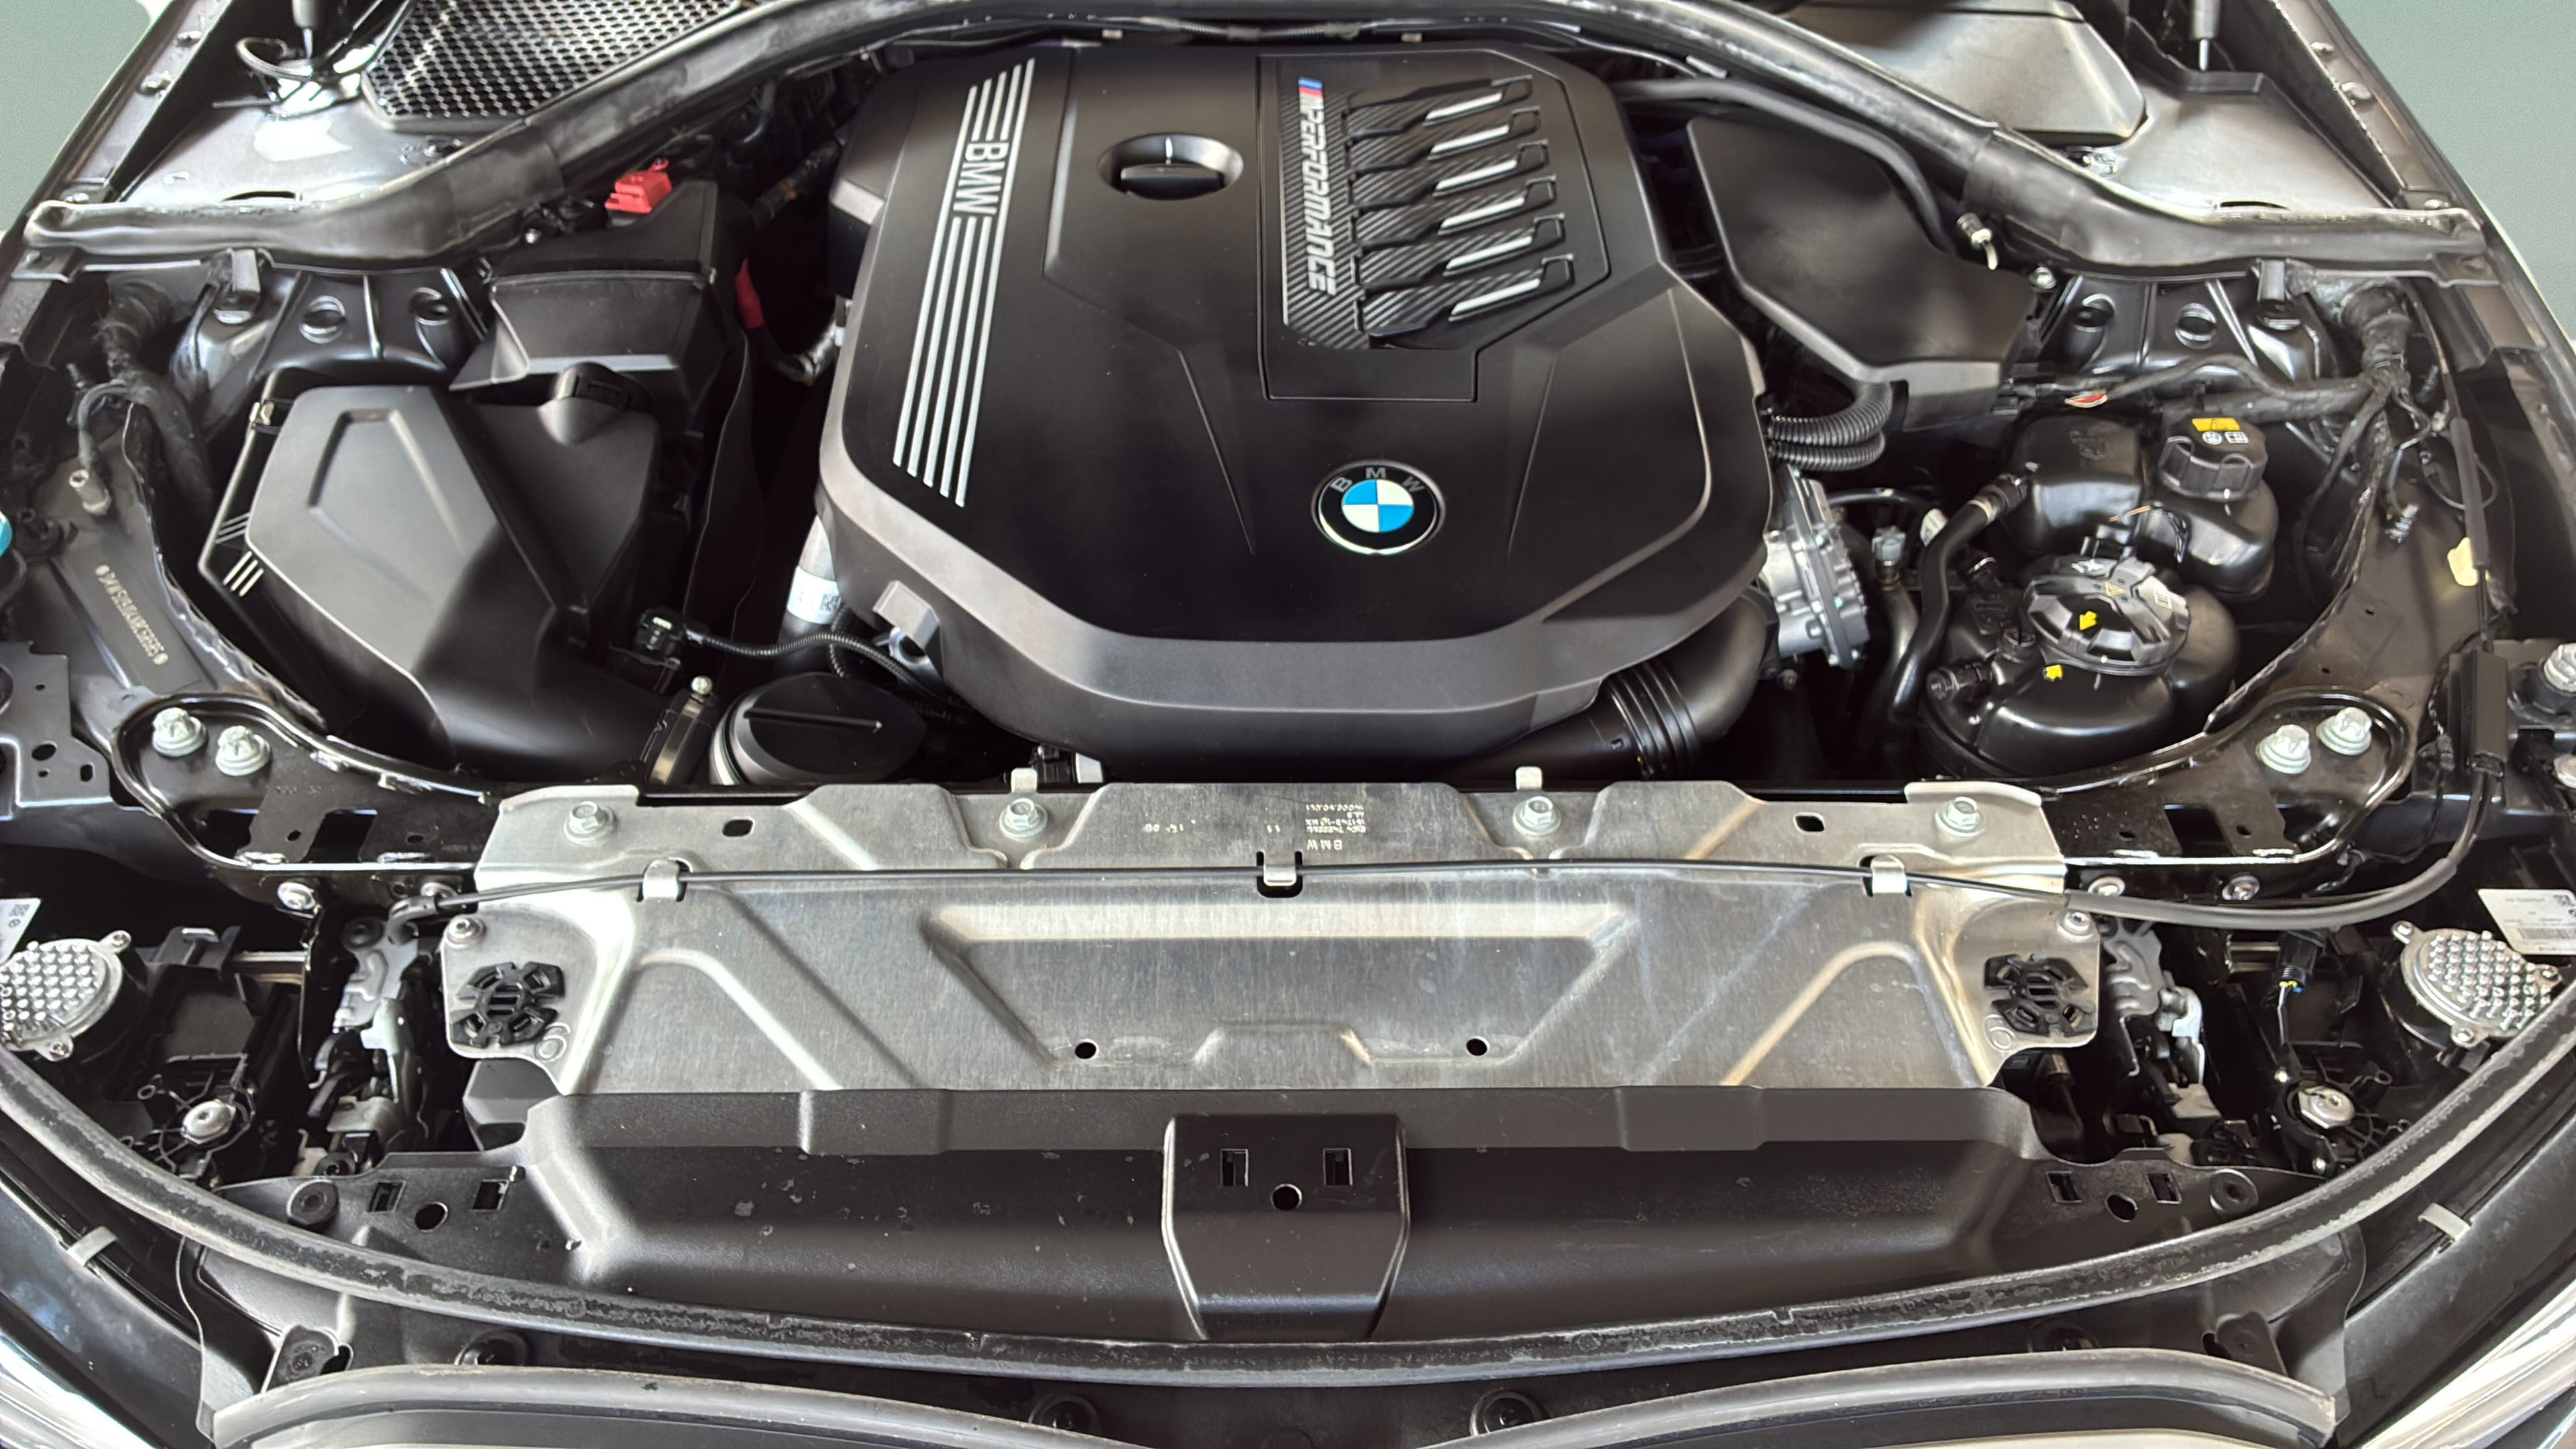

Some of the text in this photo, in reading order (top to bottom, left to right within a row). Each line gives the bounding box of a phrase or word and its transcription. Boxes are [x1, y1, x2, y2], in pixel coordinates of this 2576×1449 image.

[952, 141, 1009, 215] BMW
[1299, 107, 1336, 296] PERFORMANCE
[1329, 467, 1426, 494] BMW
[1306, 839, 1343, 851] BMW
[534, 1022, 571, 1062] 6
